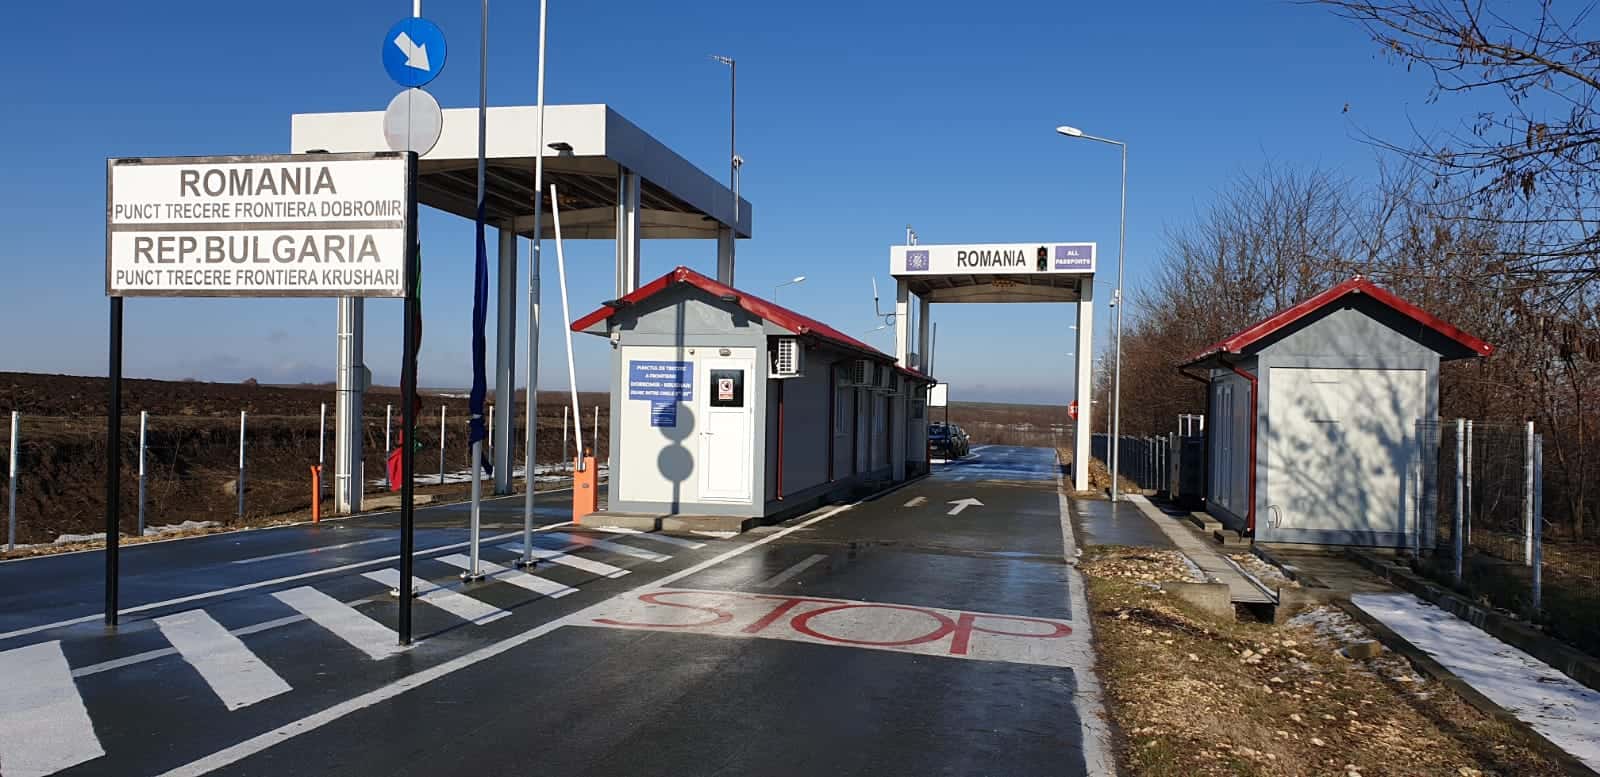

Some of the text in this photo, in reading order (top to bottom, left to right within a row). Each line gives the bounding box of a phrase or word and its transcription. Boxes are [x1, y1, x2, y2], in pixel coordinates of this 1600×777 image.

[180, 166, 337, 197] ROMANIA
[115, 199, 401, 219] PUNCT TRECERE FRONTIERA DOBROMIR
[134, 234, 381, 264] REP.BULGARIA
[957, 249, 1026, 267] ROMANIA
[116, 269, 399, 286] PUNCT TRECERE FRONTIERA KRUSHARI
[593, 591, 1072, 654] STOP
